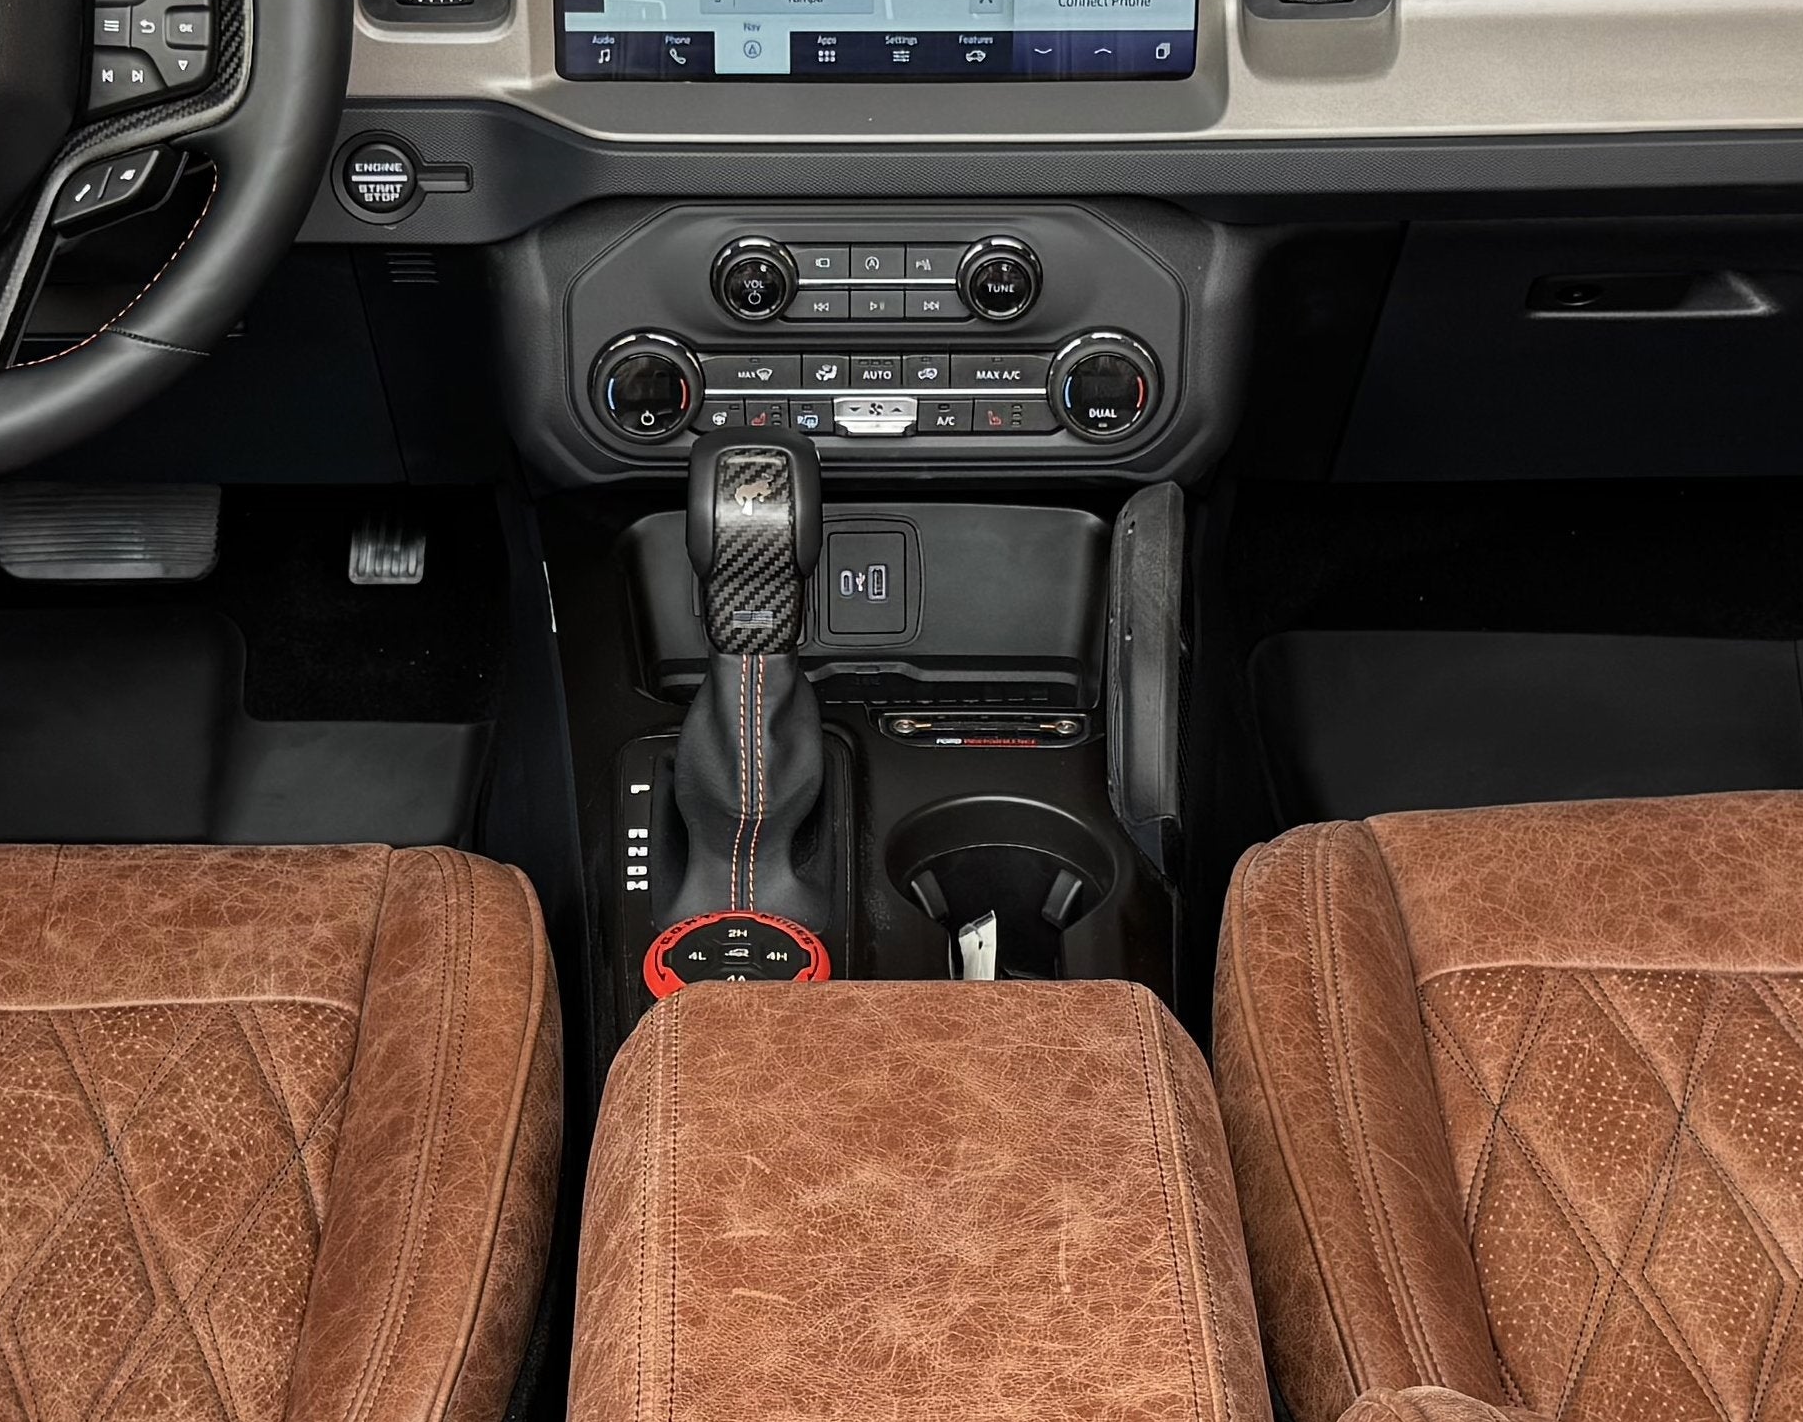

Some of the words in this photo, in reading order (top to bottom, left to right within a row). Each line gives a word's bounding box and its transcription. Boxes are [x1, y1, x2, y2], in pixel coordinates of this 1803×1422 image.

[179, 23, 193, 33] OK
[592, 35, 615, 45] Audio
[665, 35, 691, 45] Phone
[817, 36, 837, 46] Apps
[885, 35, 918, 46] Settings
[959, 34, 994, 45] Features
[355, 163, 403, 172] ENGINE
[359, 184, 403, 193] START
[364, 193, 400, 202] STOP
[744, 280, 765, 290] VOL
[987, 283, 1015, 293] TUNE
[862, 370, 892, 380] AUTO
[976, 370, 1000, 380] MAX
[1002, 370, 1021, 380] A/C
[1088, 408, 1118, 419] DUAL
[936, 416, 955, 426] A/C
[728, 929, 747, 938] 2H
[688, 951, 707, 961] 4L
[766, 951, 788, 961] 4H
